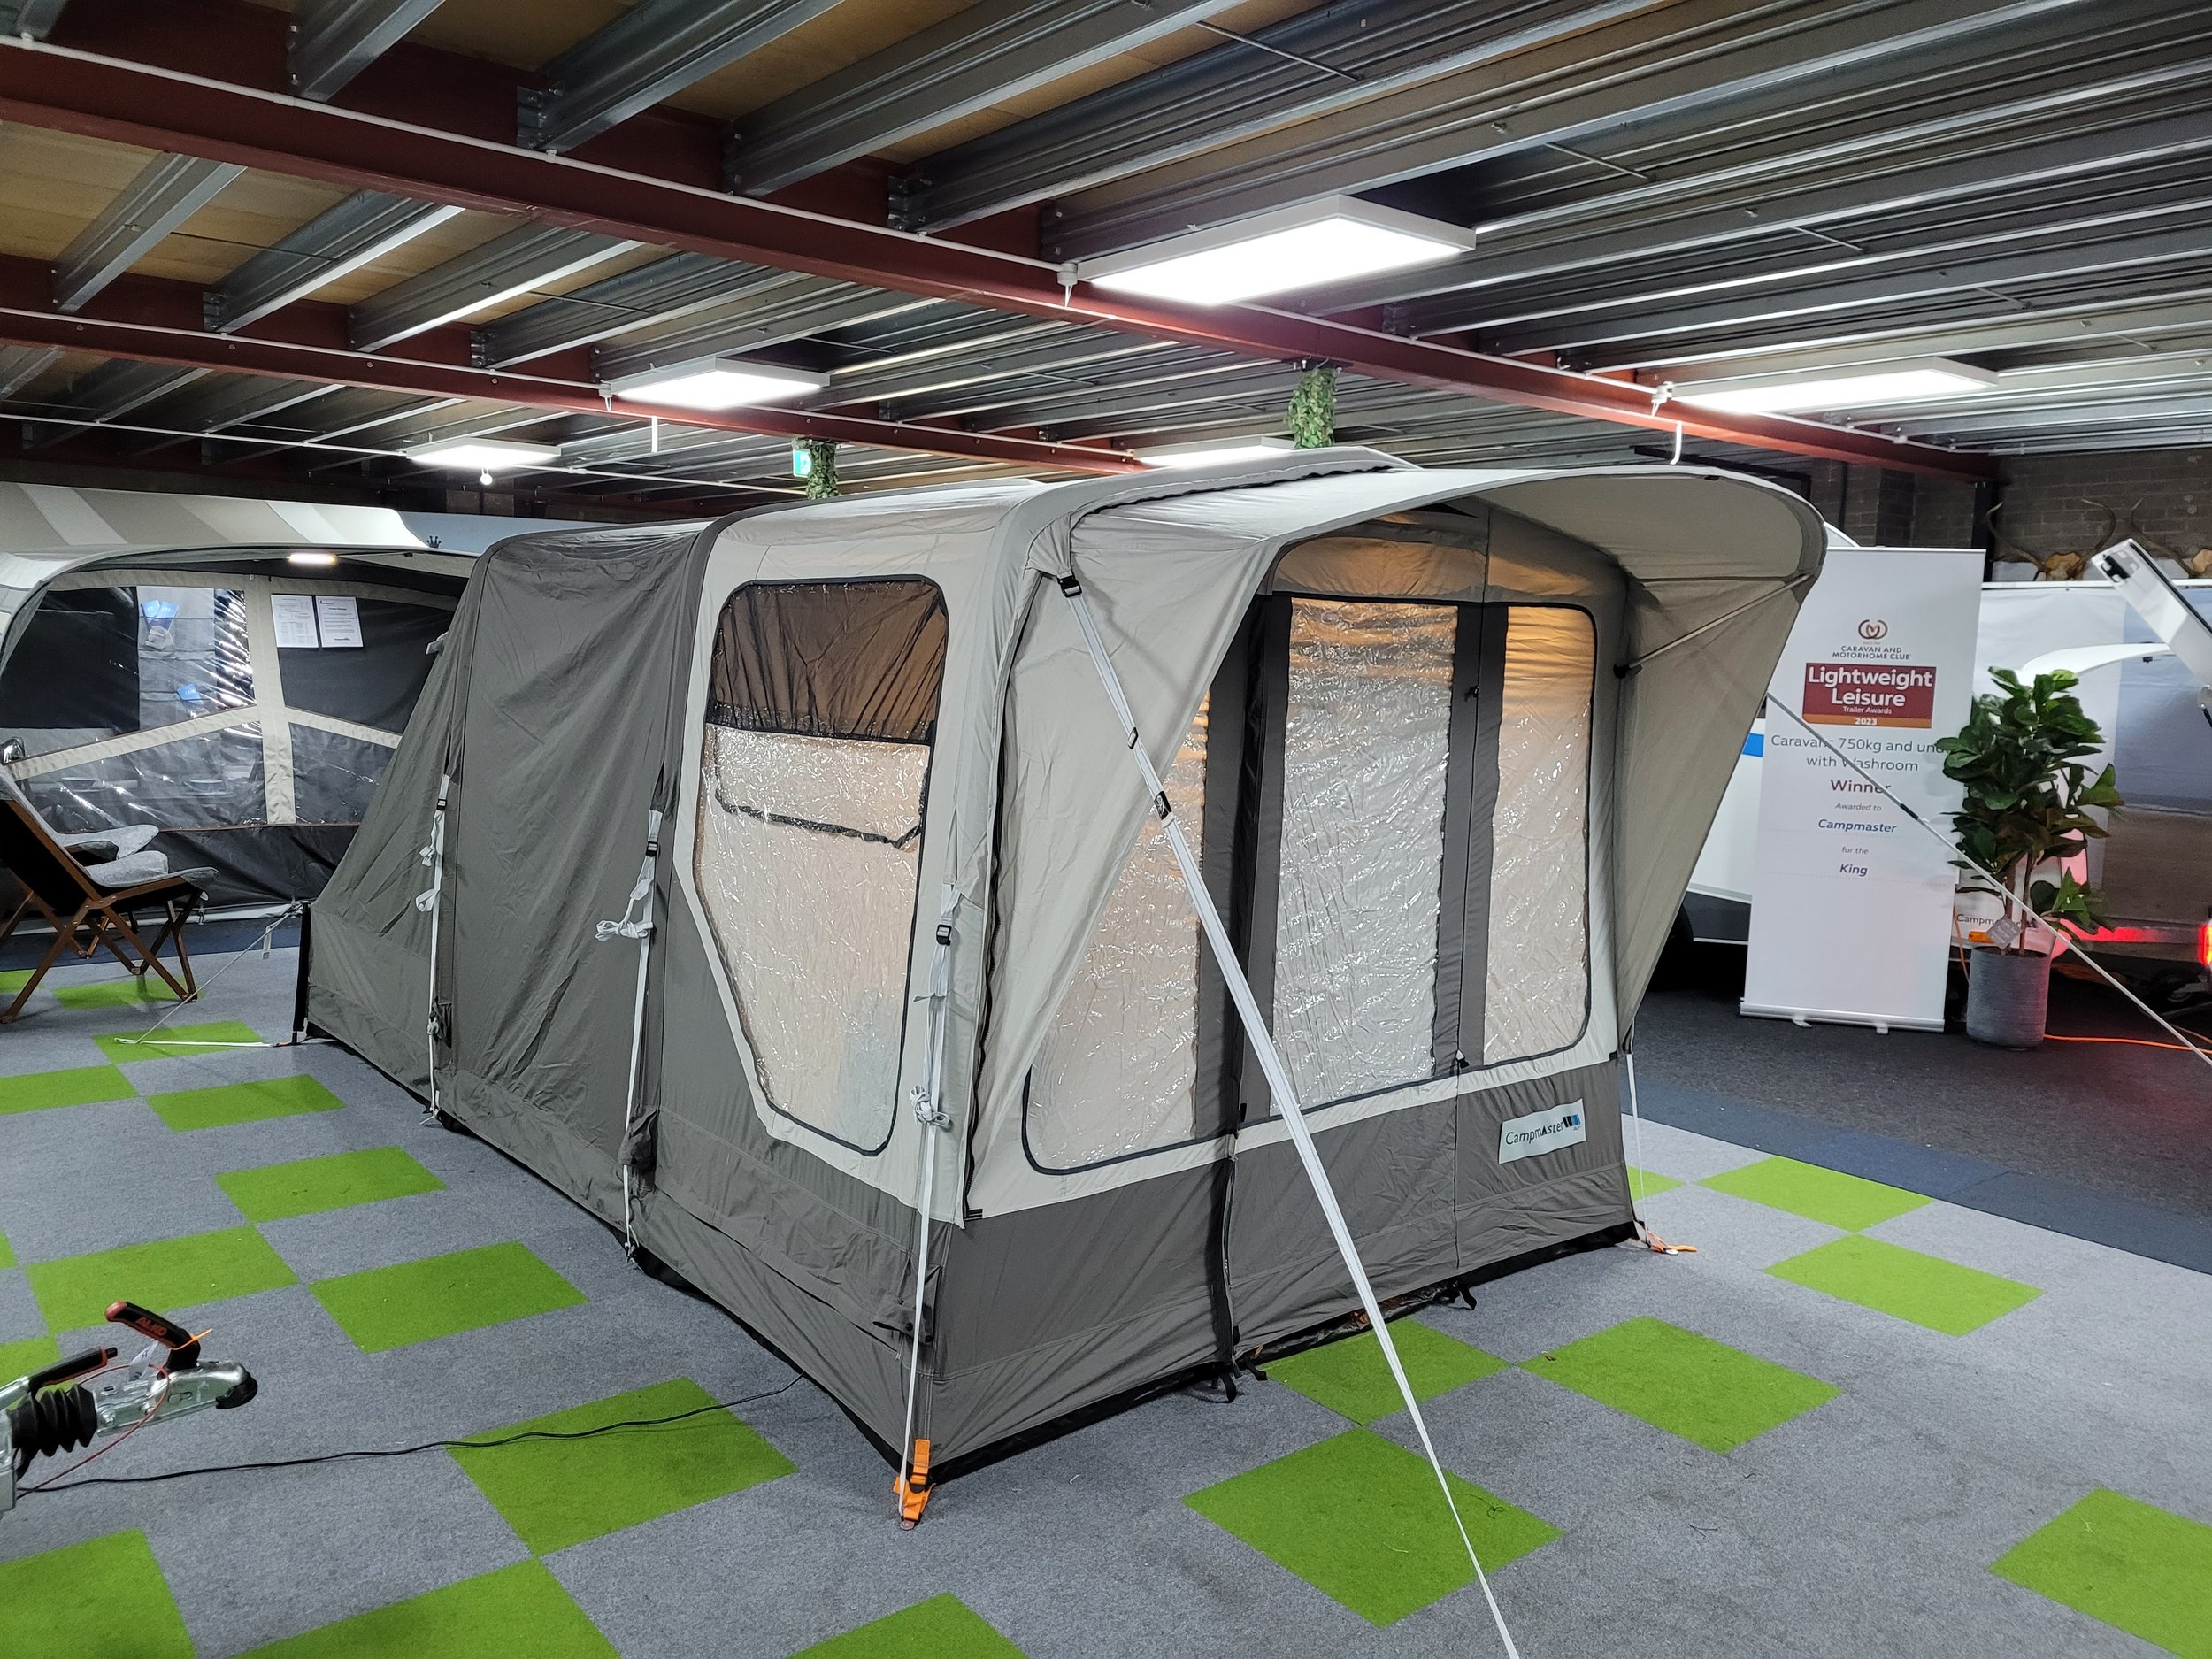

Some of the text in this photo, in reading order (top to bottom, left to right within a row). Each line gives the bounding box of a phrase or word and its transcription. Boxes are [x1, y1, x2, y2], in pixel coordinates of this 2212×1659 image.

[1832, 651, 1887, 660] MOTORHOME
[1808, 666, 1933, 691] Lightweight
[1831, 687, 1906, 707] Leisure
[1855, 717, 1878, 726] 2023
[1839, 737, 1882, 754] 750kg
[1886, 741, 1913, 752] and
[1806, 755, 1837, 768] with
[1835, 803, 1871, 811] Awarded
[1818, 819, 1897, 833] Campmaster
[1839, 864, 1868, 877] King
